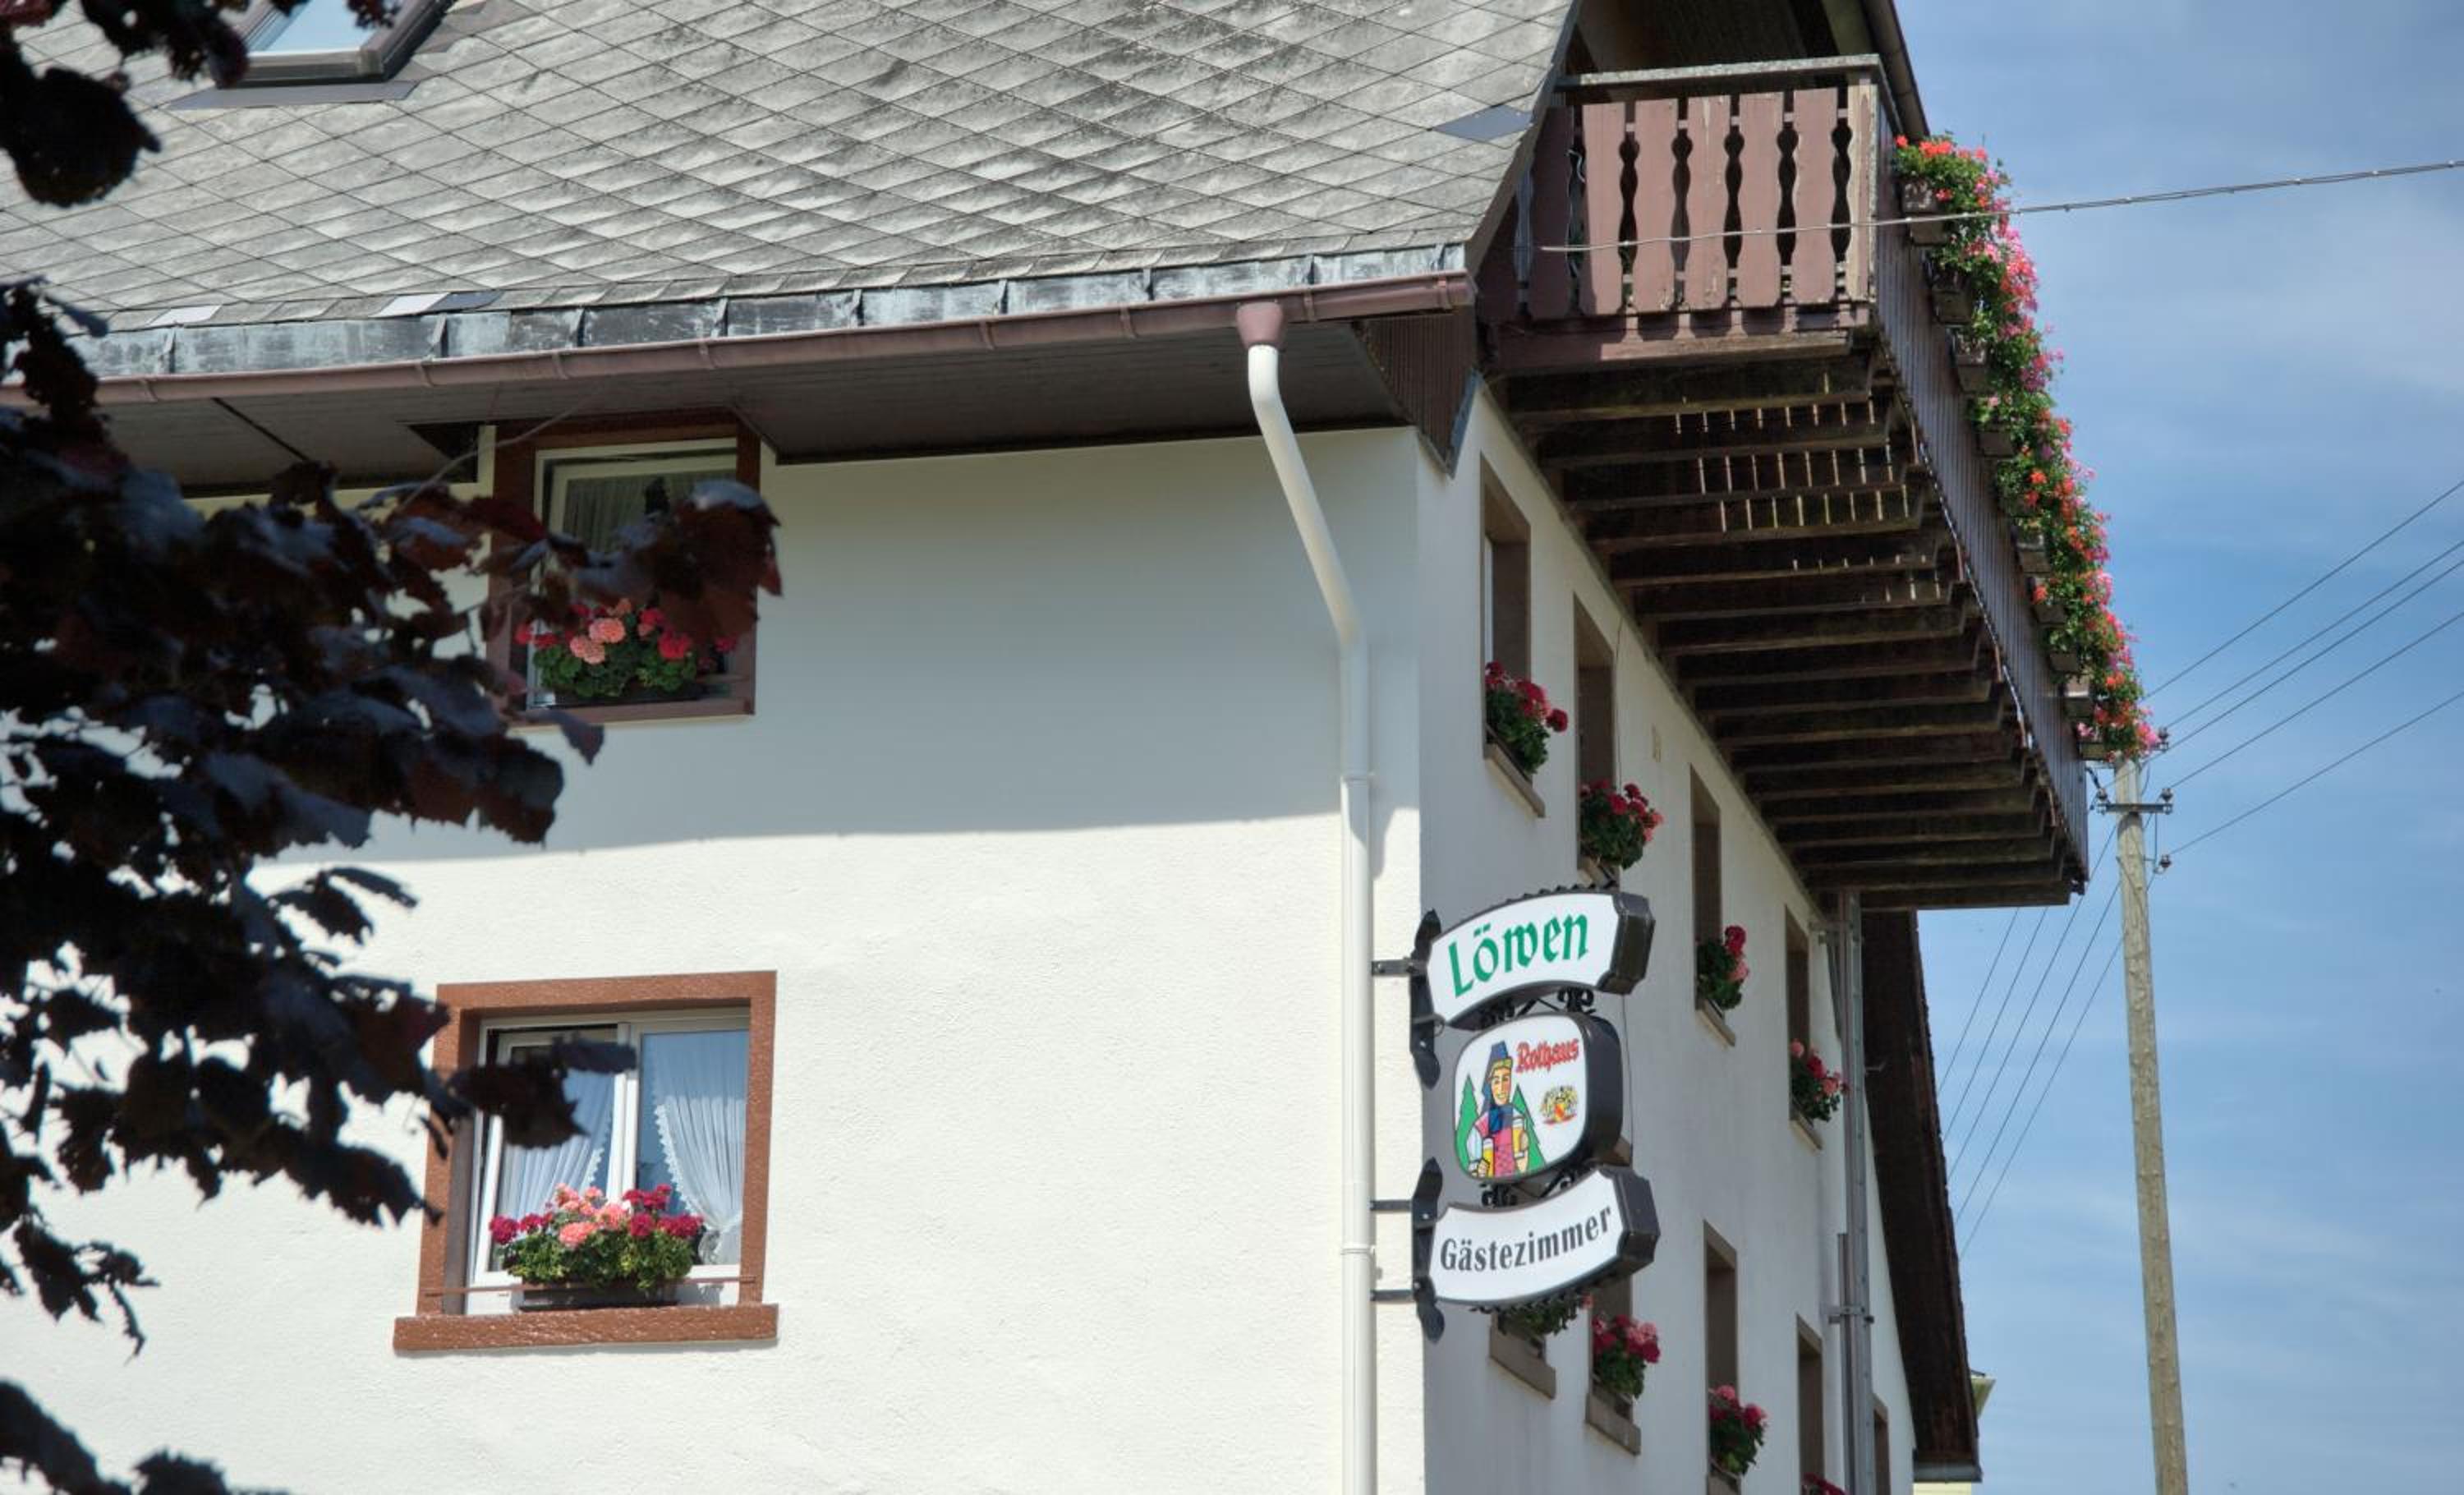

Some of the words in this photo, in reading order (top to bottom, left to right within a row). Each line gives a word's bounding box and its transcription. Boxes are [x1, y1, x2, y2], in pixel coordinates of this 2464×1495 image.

[1448, 913, 1588, 997] Löwen
[1515, 1038, 1579, 1073] Rothaus
[1441, 1206, 1611, 1272] Gästezimmer
